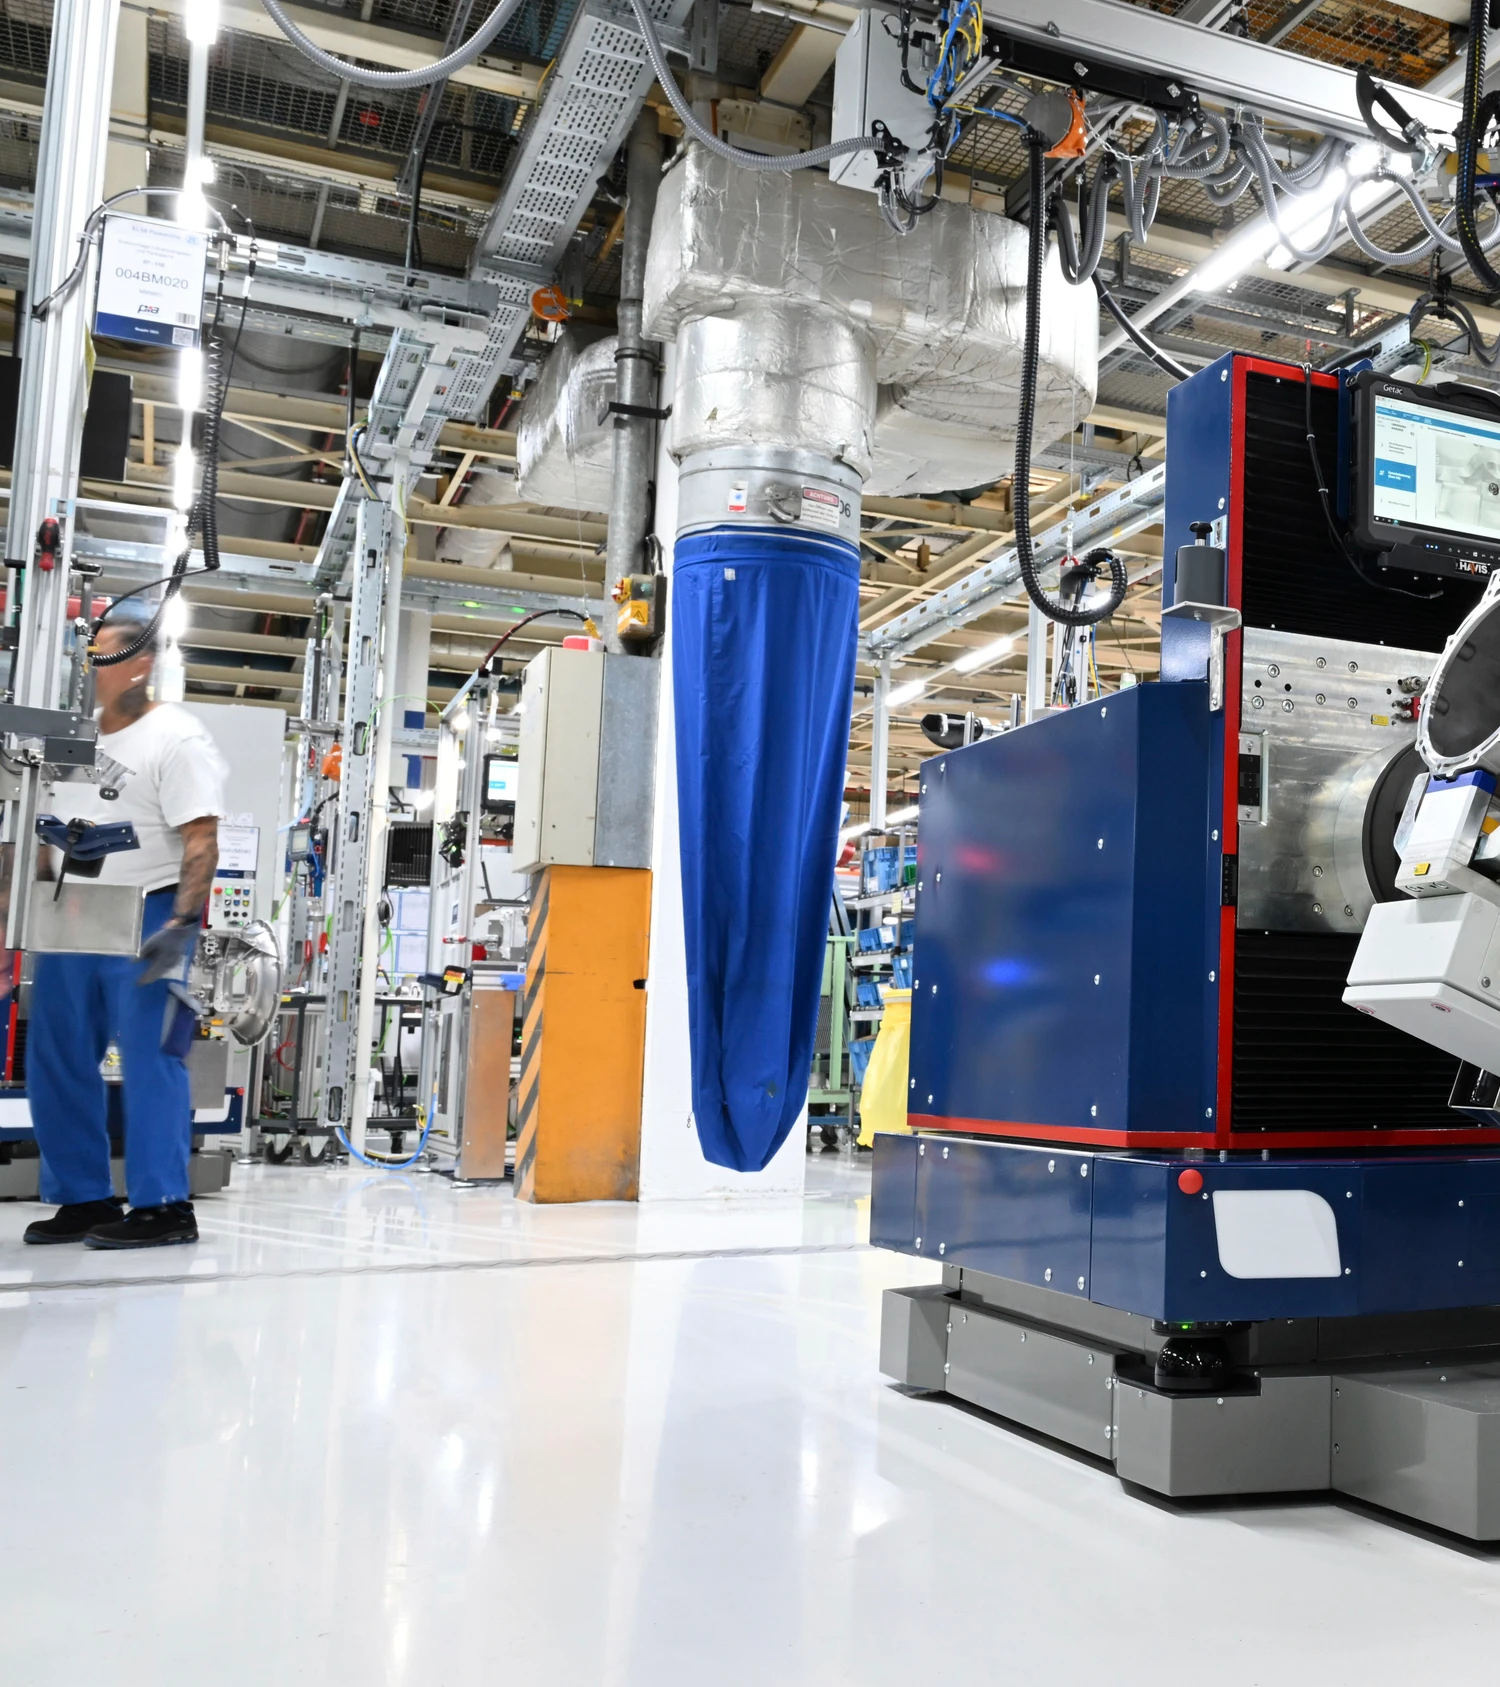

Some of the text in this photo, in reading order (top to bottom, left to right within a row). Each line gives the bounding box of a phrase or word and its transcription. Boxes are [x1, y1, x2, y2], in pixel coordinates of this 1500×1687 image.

[115, 267, 189, 290] 004BM020
[1383, 384, 1403, 395] Getac
[809, 491, 835, 503] ACHTUNG
[1459, 561, 1488, 576] HAVIS
